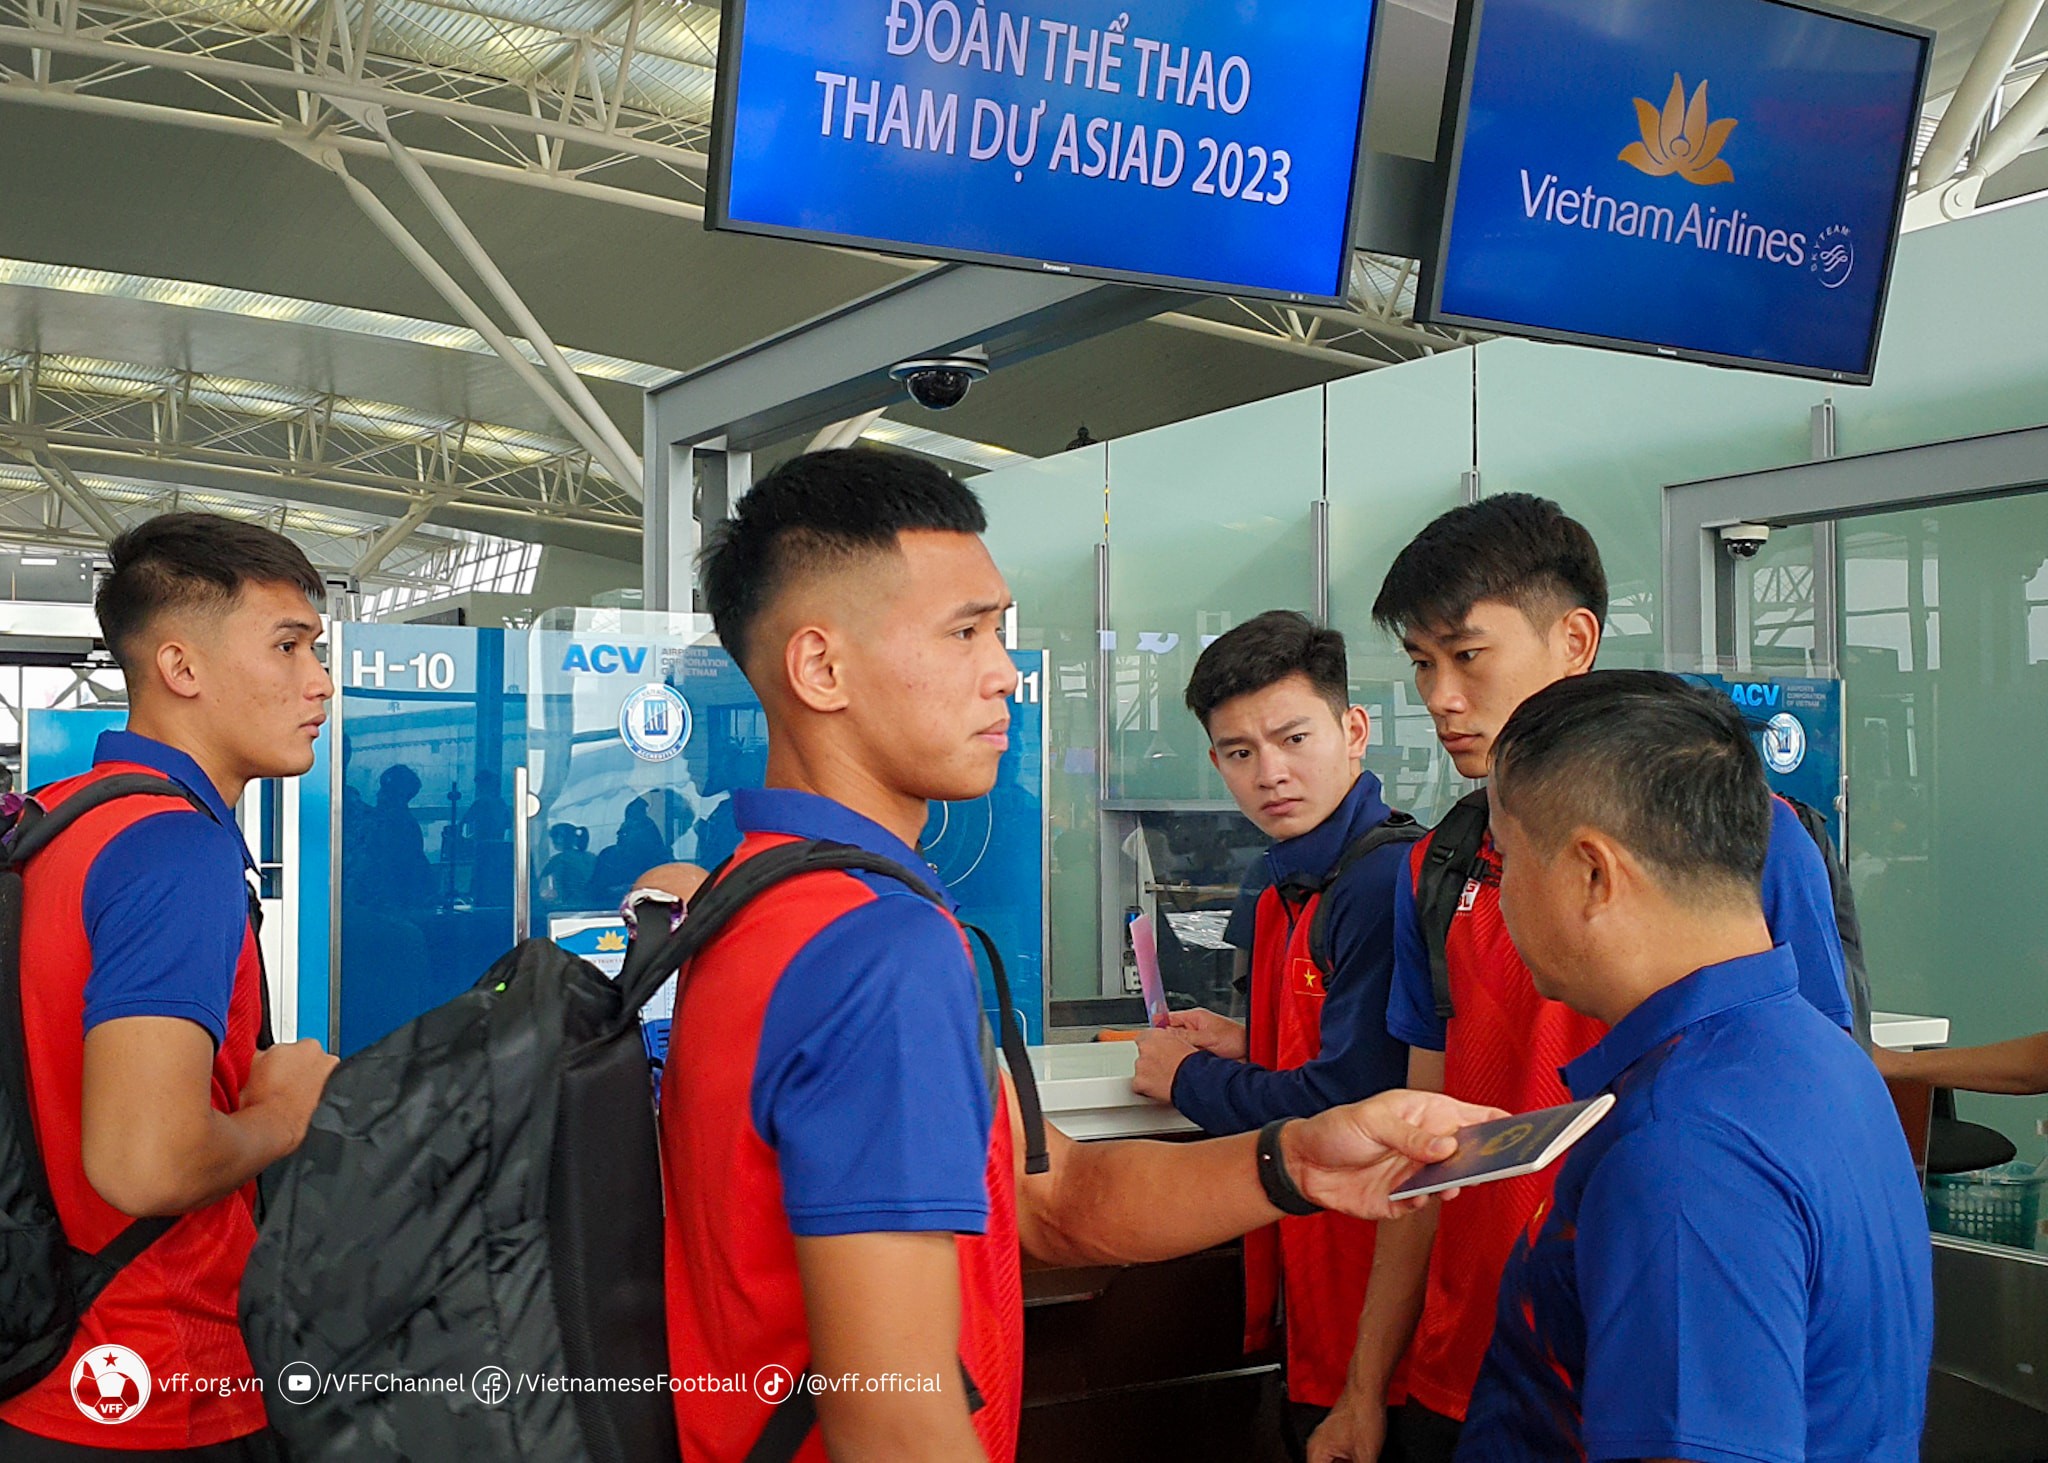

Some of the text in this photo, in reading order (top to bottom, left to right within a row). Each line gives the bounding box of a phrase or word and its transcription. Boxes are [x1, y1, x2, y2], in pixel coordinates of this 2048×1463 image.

[885, 0, 1250, 114] ĐOÀN THỂ THAO
[815, 71, 1291, 205] THAM DỰ ASIAD 2023
[1520, 169, 1806, 266] Vietnam Airlines
[352, 650, 455, 690] H-10
[561, 644, 648, 674] ACV
[1732, 684, 1780, 706] ACV
